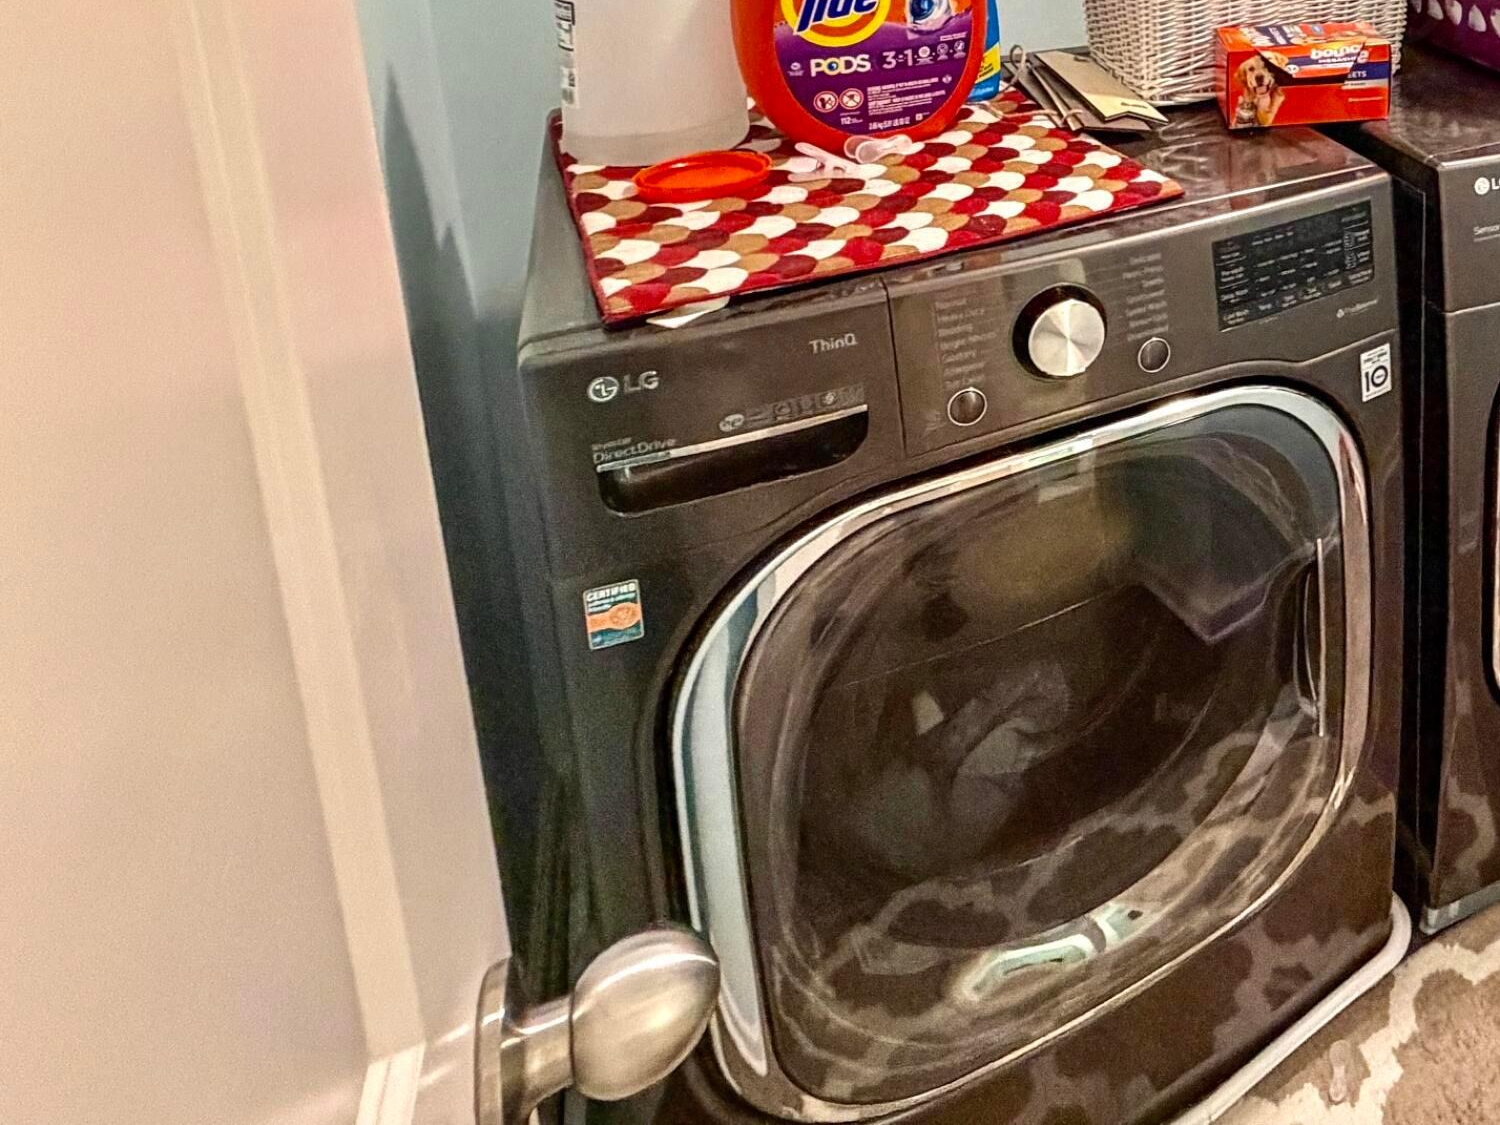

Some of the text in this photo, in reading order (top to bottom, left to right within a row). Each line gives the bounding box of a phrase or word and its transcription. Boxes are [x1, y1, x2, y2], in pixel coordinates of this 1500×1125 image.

[810, 54, 872, 77] PODS
[809, 333, 858, 355] ThinQ
[624, 370, 660, 393] LG
